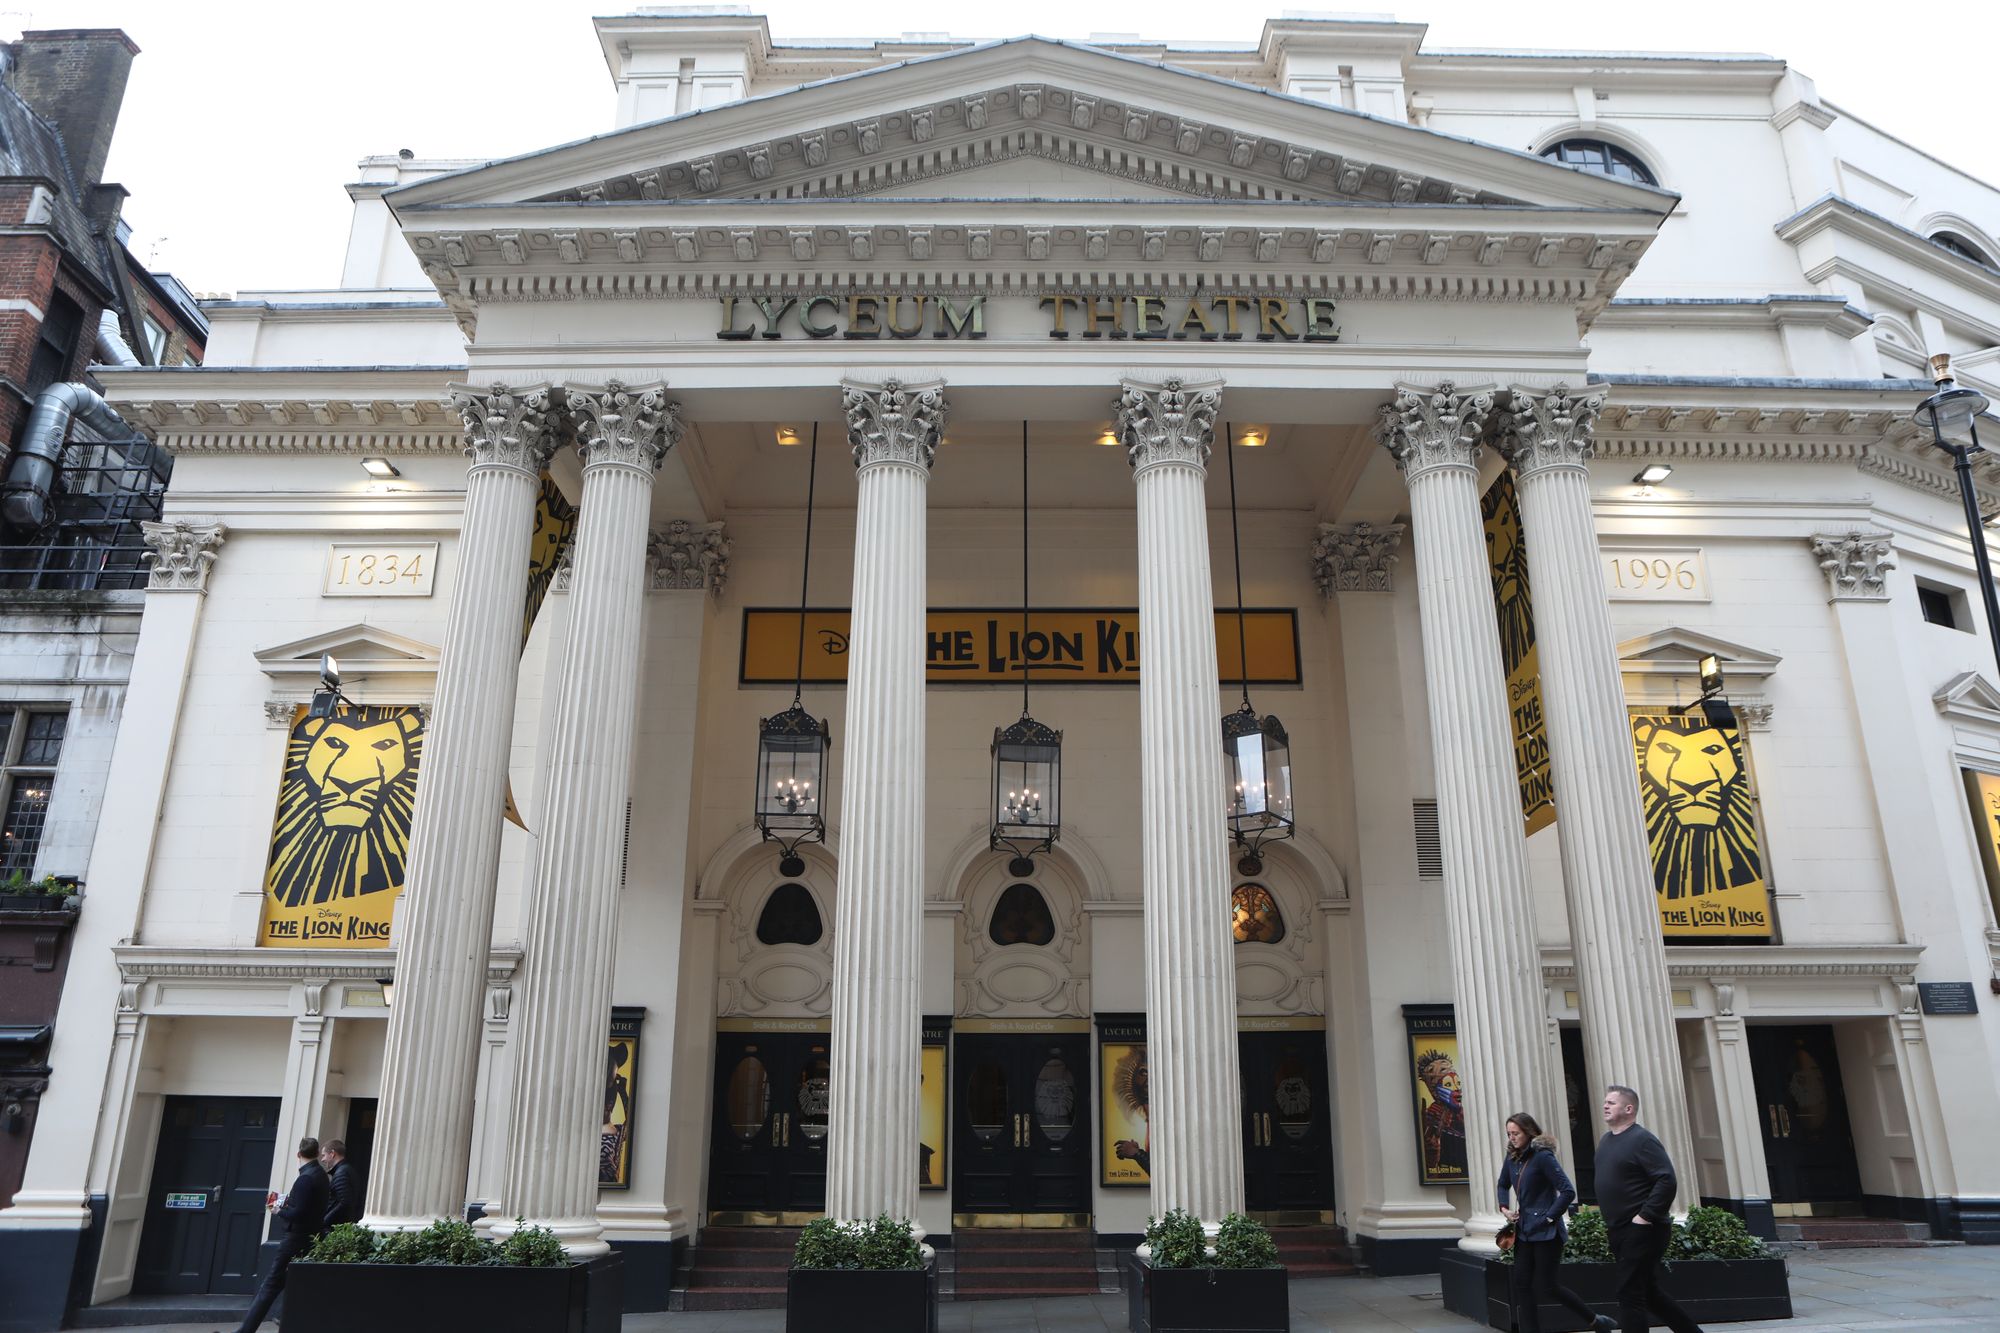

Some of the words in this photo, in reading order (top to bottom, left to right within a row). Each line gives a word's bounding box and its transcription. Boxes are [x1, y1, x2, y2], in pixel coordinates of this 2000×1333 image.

[716, 295, 988, 339] LYCEUM
[1039, 296, 1342, 340] THEATRE
[337, 554, 423, 586] 1834
[1609, 559, 1696, 590] 1996
[926, 631, 975, 662] HE
[986, 620, 1083, 673] LION
[1095, 620, 1139, 673] KI
[1513, 696, 1542, 733] THE
[1515, 731, 1549, 773] LION
[269, 920, 299, 935] THE
[301, 916, 343, 940] LION
[346, 916, 390, 940] KING
[1662, 911, 1688, 923] THE
[1690, 907, 1726, 927] LION
[1728, 906, 1765, 927] KING
[610, 1023, 634, 1031] ATRE
[1104, 1027, 1141, 1036] LYCEUM
[1413, 1020, 1452, 1028] LYCEUM
